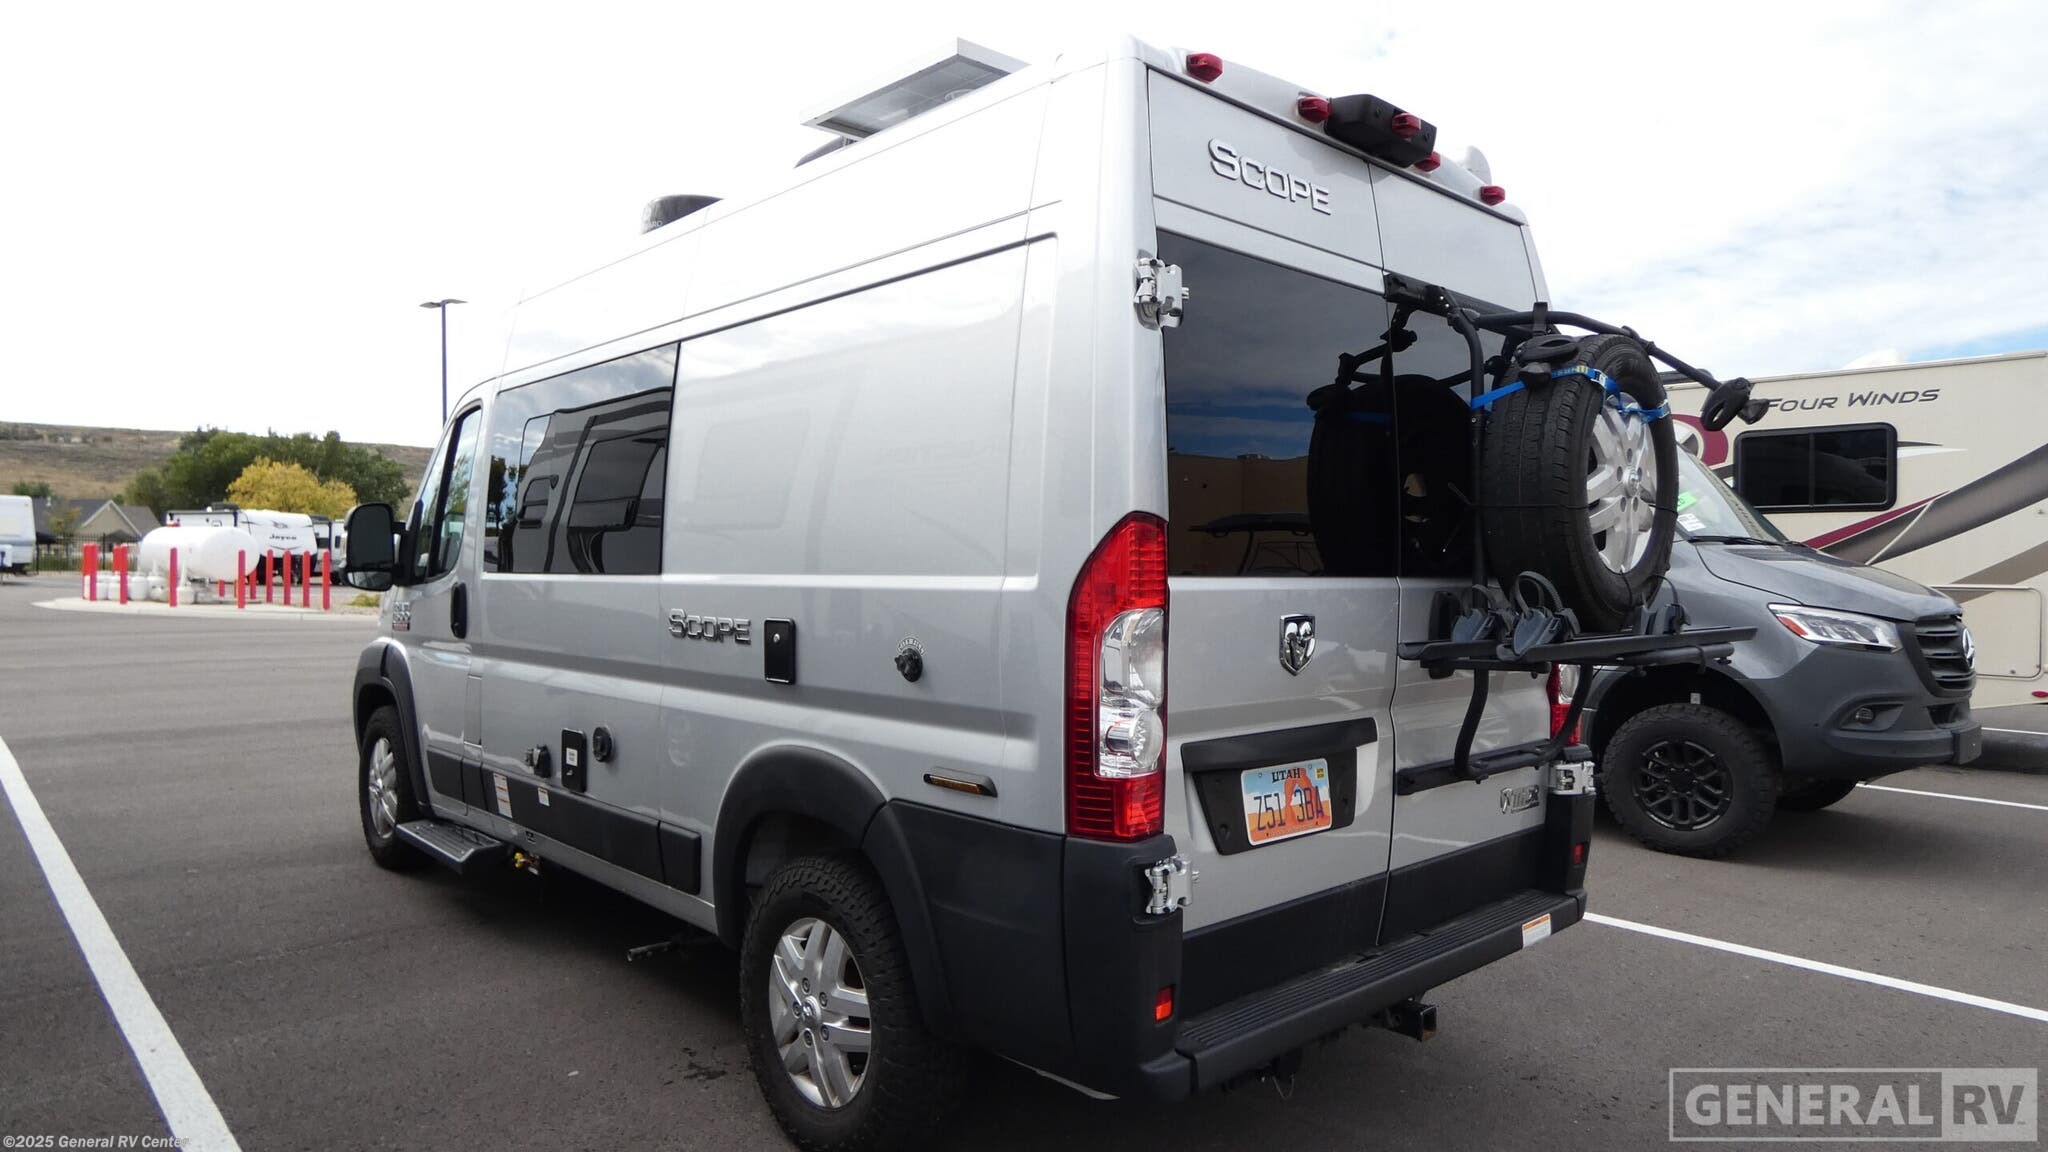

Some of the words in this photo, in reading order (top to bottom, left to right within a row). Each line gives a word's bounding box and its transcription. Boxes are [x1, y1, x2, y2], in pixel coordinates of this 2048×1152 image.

[1208, 138, 1331, 215] SCOPE
[1848, 389, 1940, 407] WINDS
[668, 608, 751, 645] SCOPE
[1271, 768, 1301, 783] UTAH
[1253, 793, 1286, 831] Z51
